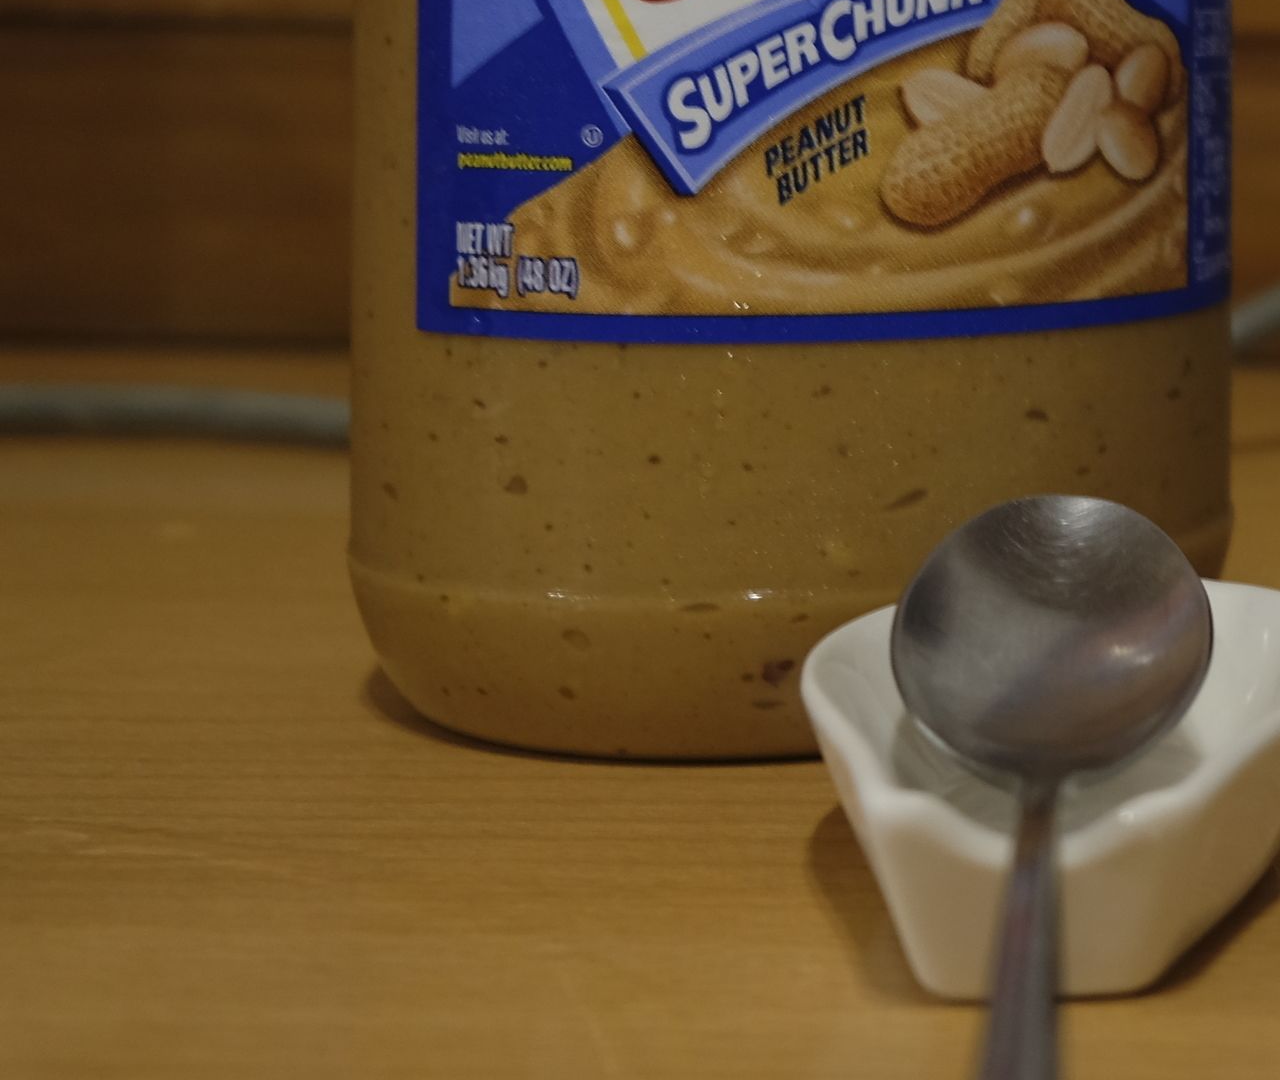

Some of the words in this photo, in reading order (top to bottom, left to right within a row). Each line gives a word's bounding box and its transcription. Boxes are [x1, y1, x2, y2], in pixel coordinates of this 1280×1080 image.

[664, 38, 820, 150] SUPER
[765, 95, 868, 179] PEANUT
[777, 128, 871, 206] BUTTER
[456, 221, 484, 254] NET
